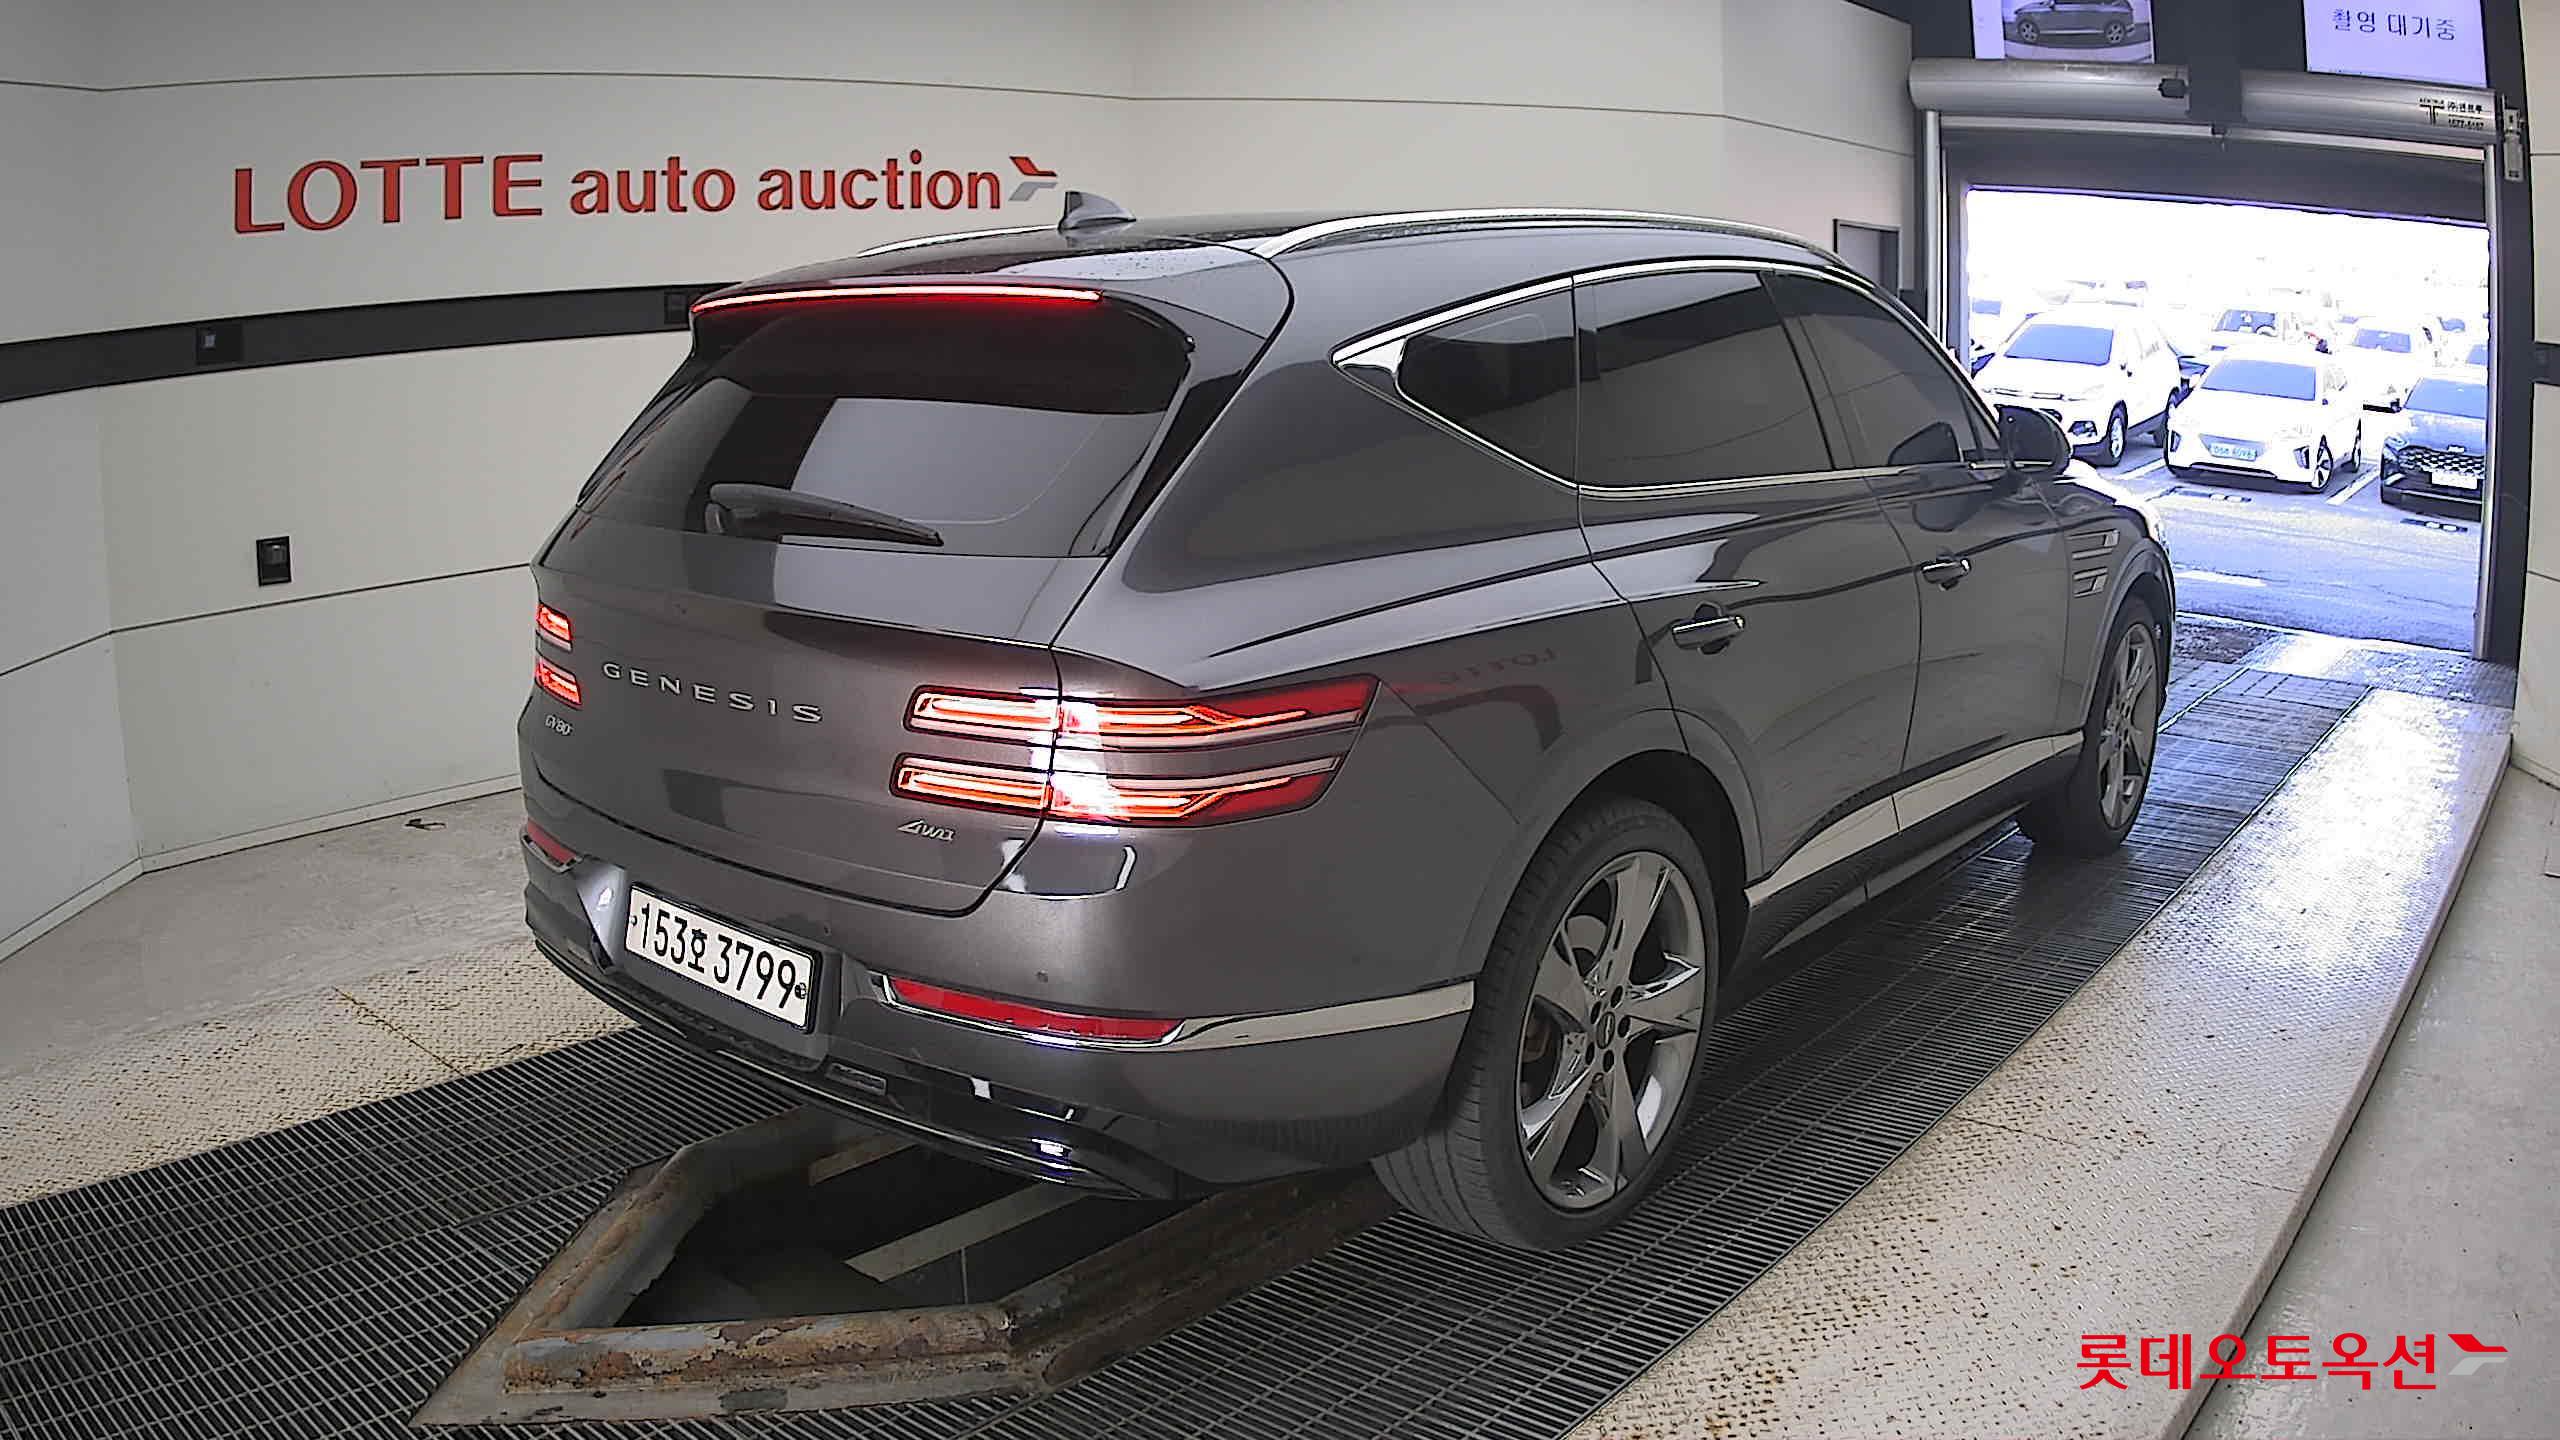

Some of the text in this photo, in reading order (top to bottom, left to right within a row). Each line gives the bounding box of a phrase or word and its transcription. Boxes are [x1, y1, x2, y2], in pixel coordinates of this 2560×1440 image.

[2332, 8, 2456, 41] 촬영 대기중
[234, 148, 1001, 234] LOTTE auto auction
[602, 663, 822, 723] GENESIS
[641, 903, 796, 1009] 153호 3799
